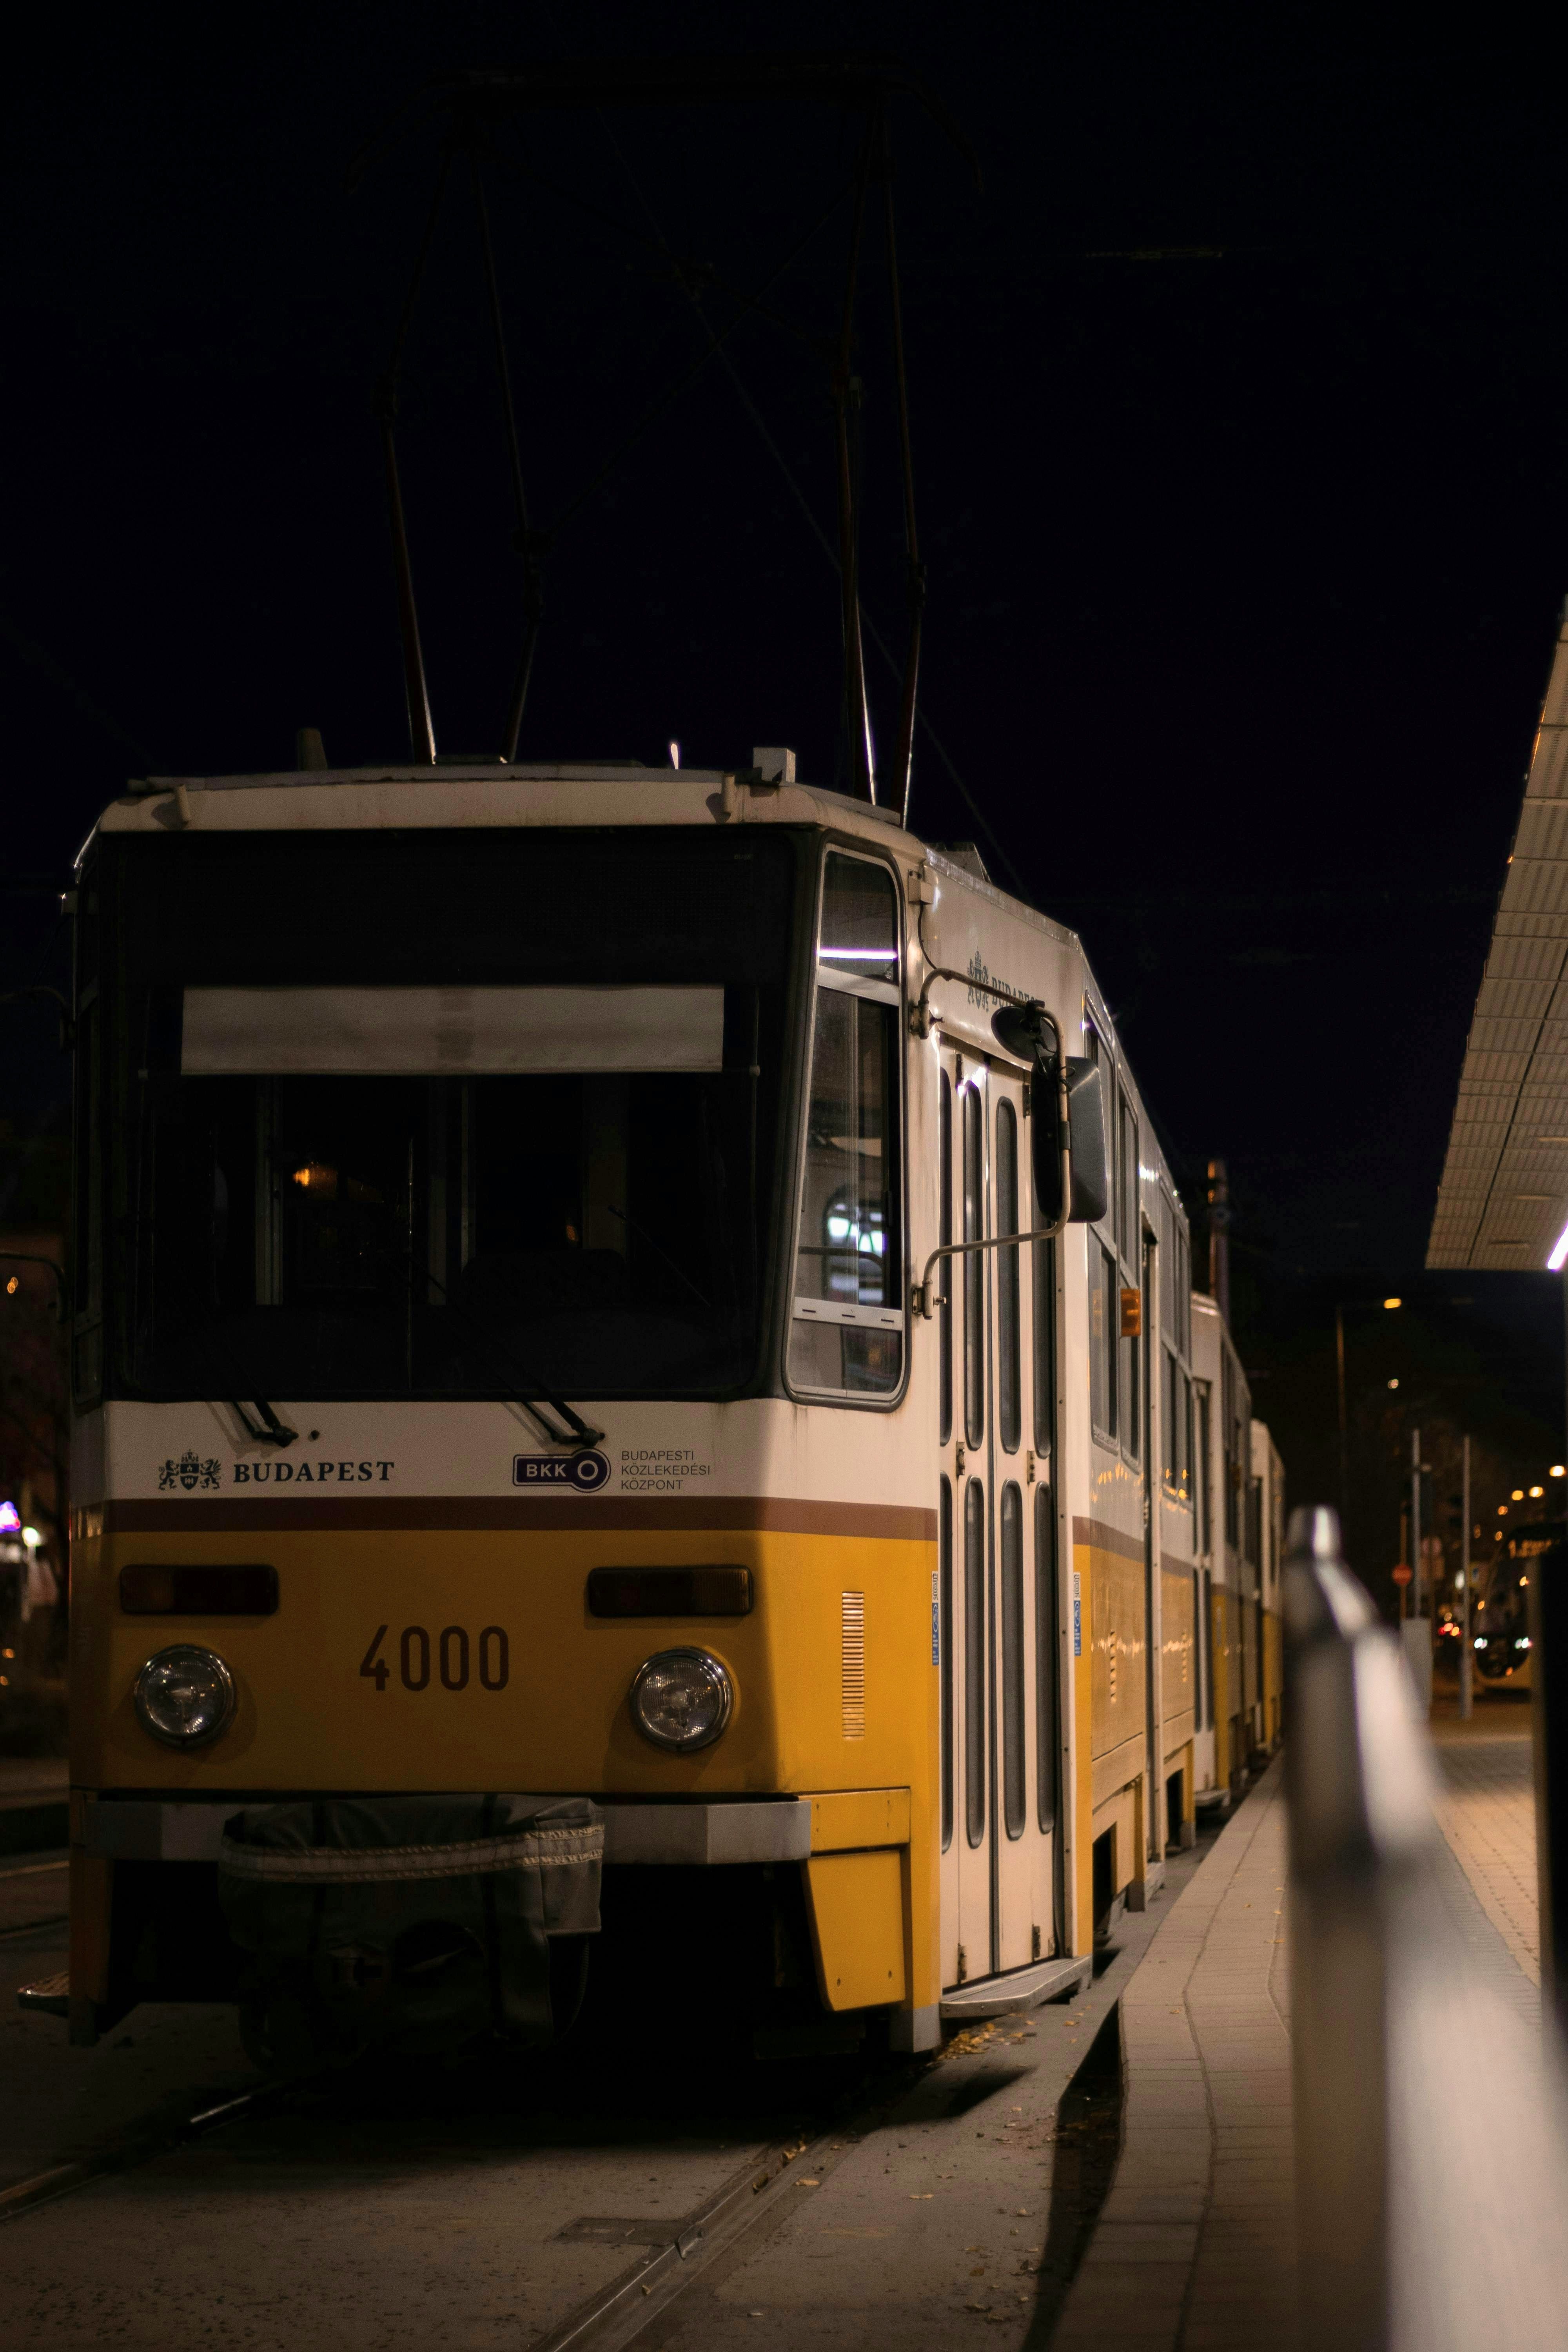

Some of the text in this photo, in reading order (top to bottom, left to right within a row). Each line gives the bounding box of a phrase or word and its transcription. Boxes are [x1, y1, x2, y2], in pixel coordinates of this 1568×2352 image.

[621, 1451, 694, 1461] BUDAPESTI
[233, 1462, 394, 1483] BUDAPEST
[526, 1464, 567, 1477] BKK
[621, 1463, 710, 1475] KÖZLEKEDÉSI
[621, 1477, 683, 1490] KÖZPONT
[360, 1625, 509, 1691] 4000
